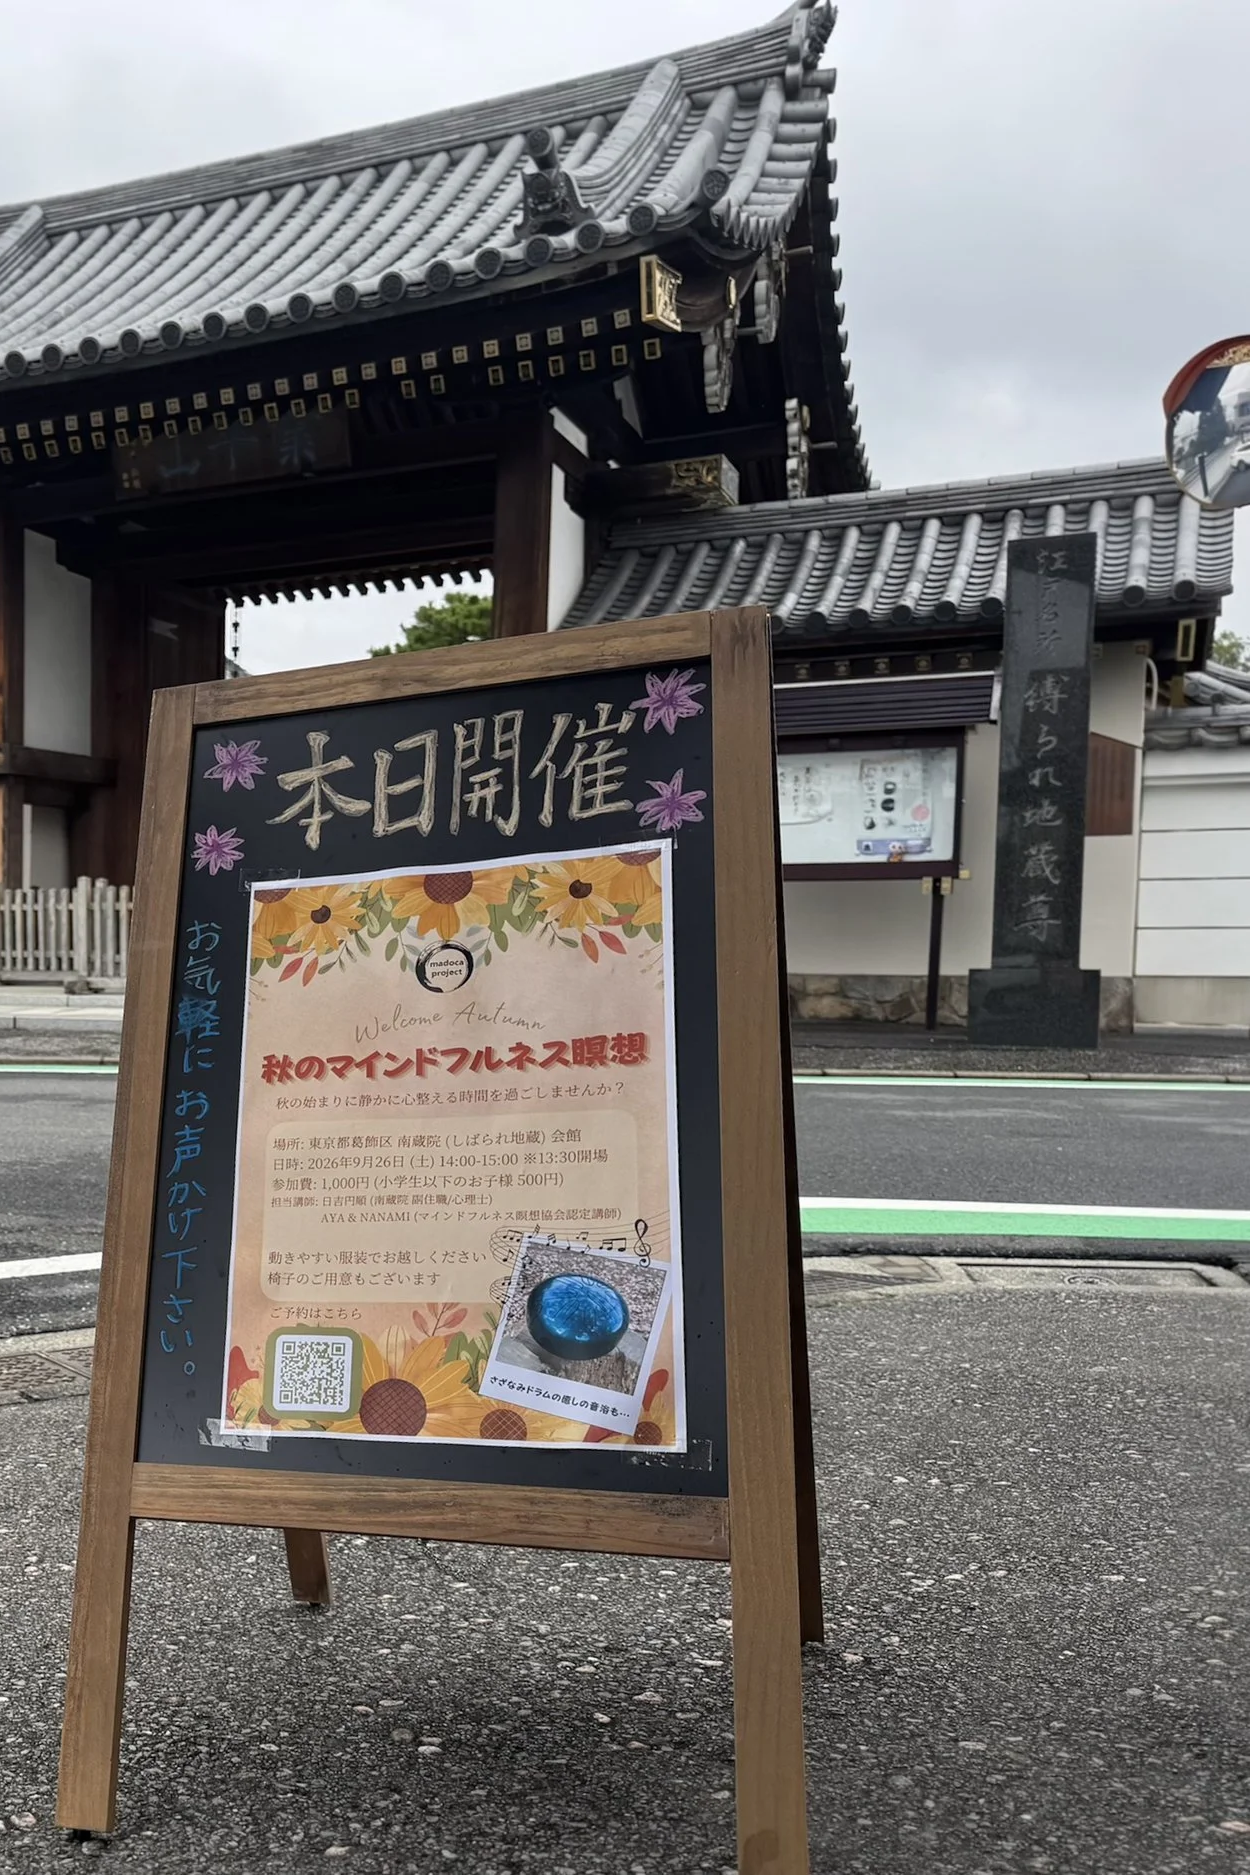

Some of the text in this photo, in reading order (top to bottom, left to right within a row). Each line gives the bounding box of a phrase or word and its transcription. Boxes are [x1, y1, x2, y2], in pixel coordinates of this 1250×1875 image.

[266, 703, 636, 851] 本日開催
[430, 959, 464, 968] madoca
[431, 968, 463, 978] project
[176, 919, 223, 1074] お気軽に
[355, 1001, 546, 1043] Welcome Autumn
[261, 1032, 649, 1085] 秋のマインドフルネス瞑想
[276, 1081, 625, 1110] 秋の始まりに静かに心整える時間を過ごしませんか？
[308, 1155, 405, 1170] 2026年9月26日
[439, 1153, 519, 1168] 14:00-15:00
[321, 1176, 370, 1191] 1,000円
[321, 1212, 345, 1223] AYA
[347, 1212, 357, 1223] &
[360, 1211, 410, 1223] NANAMI
[268, 1250, 487, 1265] 動きやすい服装でお越しください
[268, 1271, 441, 1286] 椅子のご用意もございます
[270, 1307, 363, 1320] ご予約はこちら
